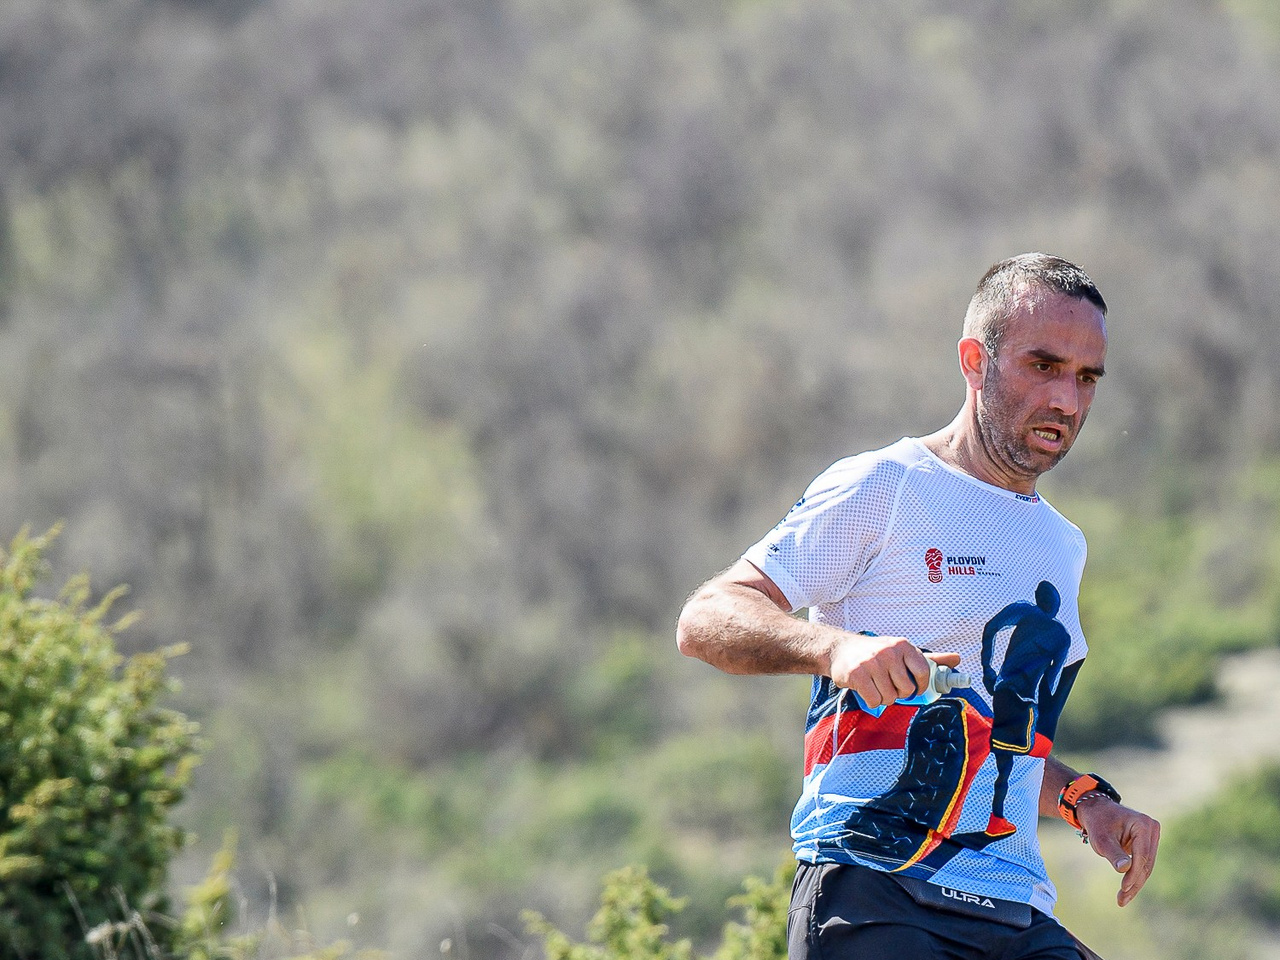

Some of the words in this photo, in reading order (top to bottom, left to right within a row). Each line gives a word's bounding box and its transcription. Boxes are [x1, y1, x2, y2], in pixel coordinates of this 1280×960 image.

[947, 556, 986, 566] PLOVDIV
[948, 566, 975, 576] HILLS
[941, 887, 996, 909] ULTRA
